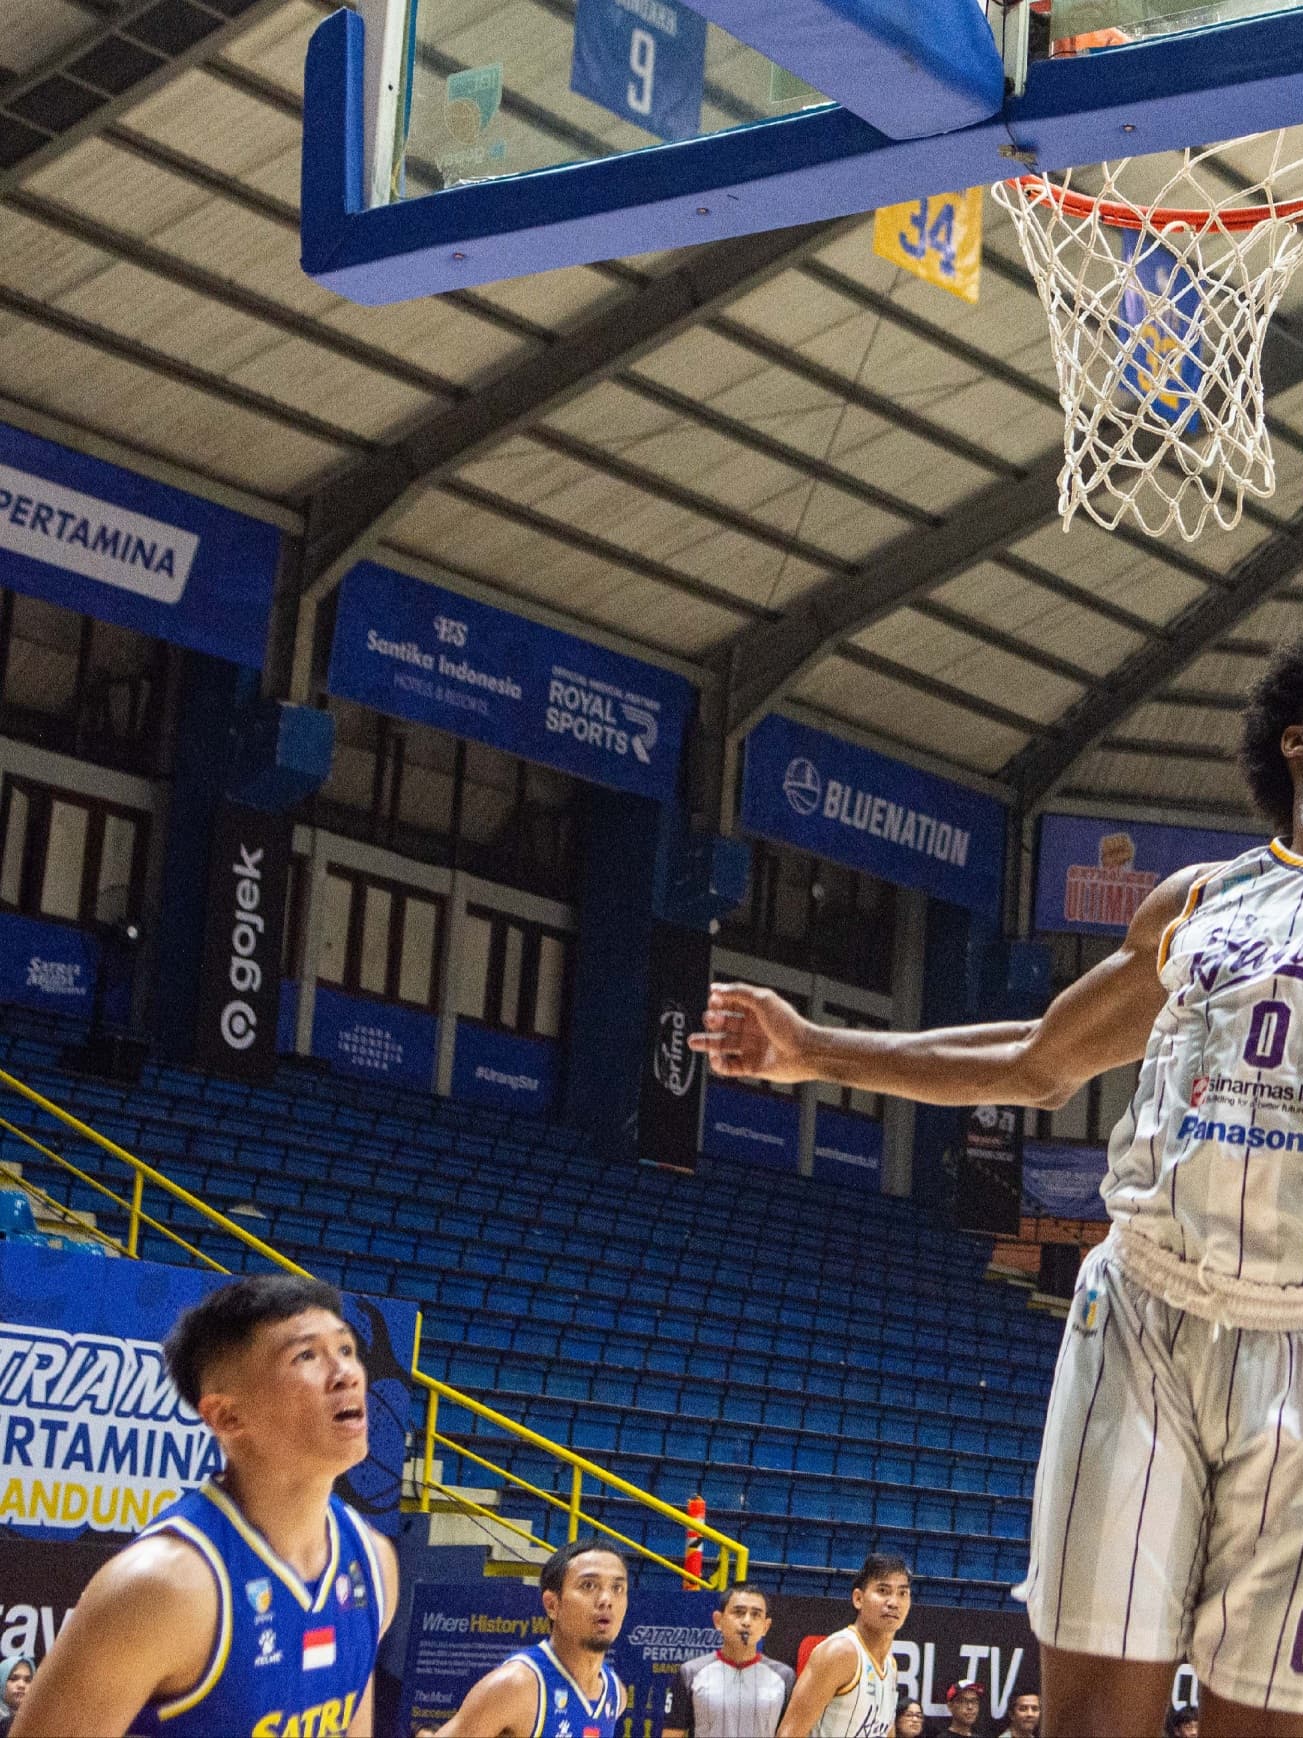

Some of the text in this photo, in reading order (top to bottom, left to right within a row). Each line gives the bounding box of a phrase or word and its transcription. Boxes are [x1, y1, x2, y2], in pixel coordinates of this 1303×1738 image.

[627, 27, 655, 115] 9
[367, 629, 522, 699] Santika Indonesia
[546, 706, 628, 755] SPORTS
[550, 679, 617, 725] ROYAL
[823, 779, 971, 867] BLUENATION
[229, 843, 264, 992] gojek
[1243, 1000, 1291, 1069] 0
[1208, 1073, 1295, 1101] sinarmas
[422, 1612, 469, 1633] Where
[470, 1613, 531, 1638] History
[960, 1644, 1023, 1720] TV
